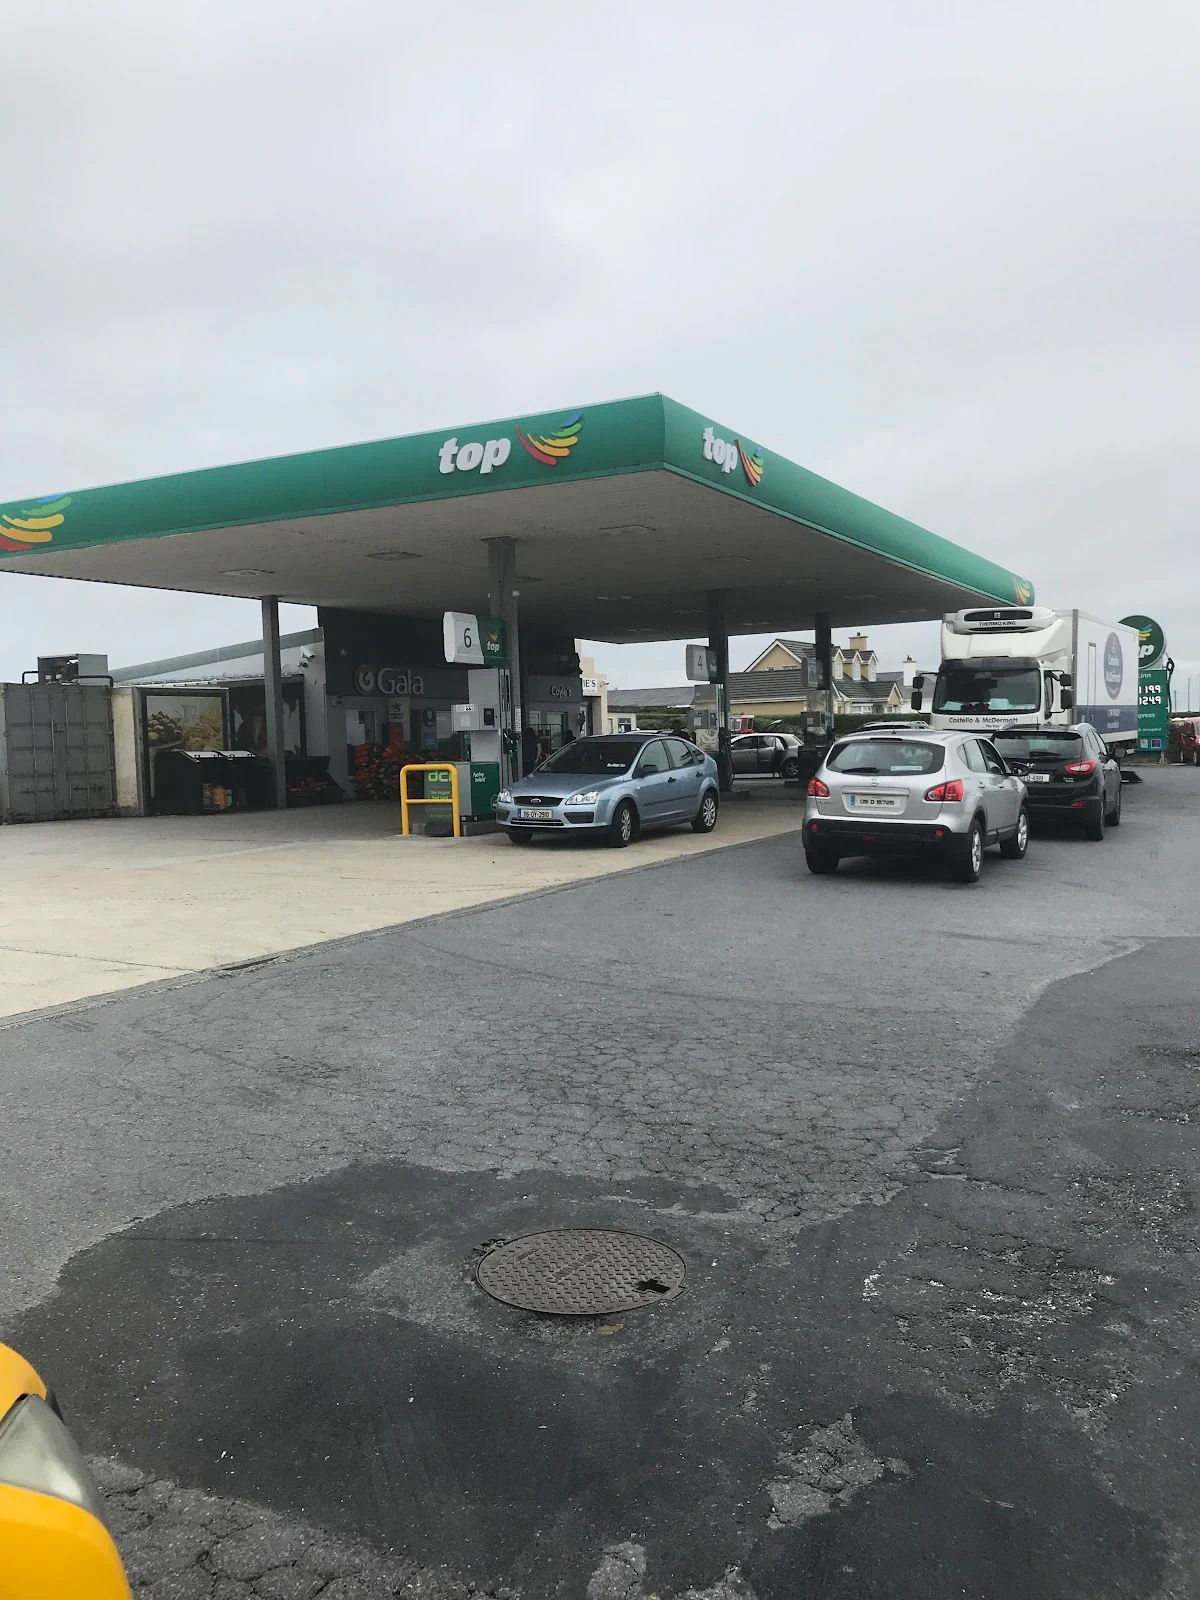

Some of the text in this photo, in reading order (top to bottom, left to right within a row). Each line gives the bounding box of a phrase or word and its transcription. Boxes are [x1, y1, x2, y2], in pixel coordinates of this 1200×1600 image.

[438, 437, 512, 475] top
[703, 426, 738, 474] top
[463, 627, 472, 648] 6
[486, 640, 500, 653] top
[697, 655, 703, 671] 4
[377, 667, 424, 695] Gala
[550, 685, 572, 698] Coyle's
